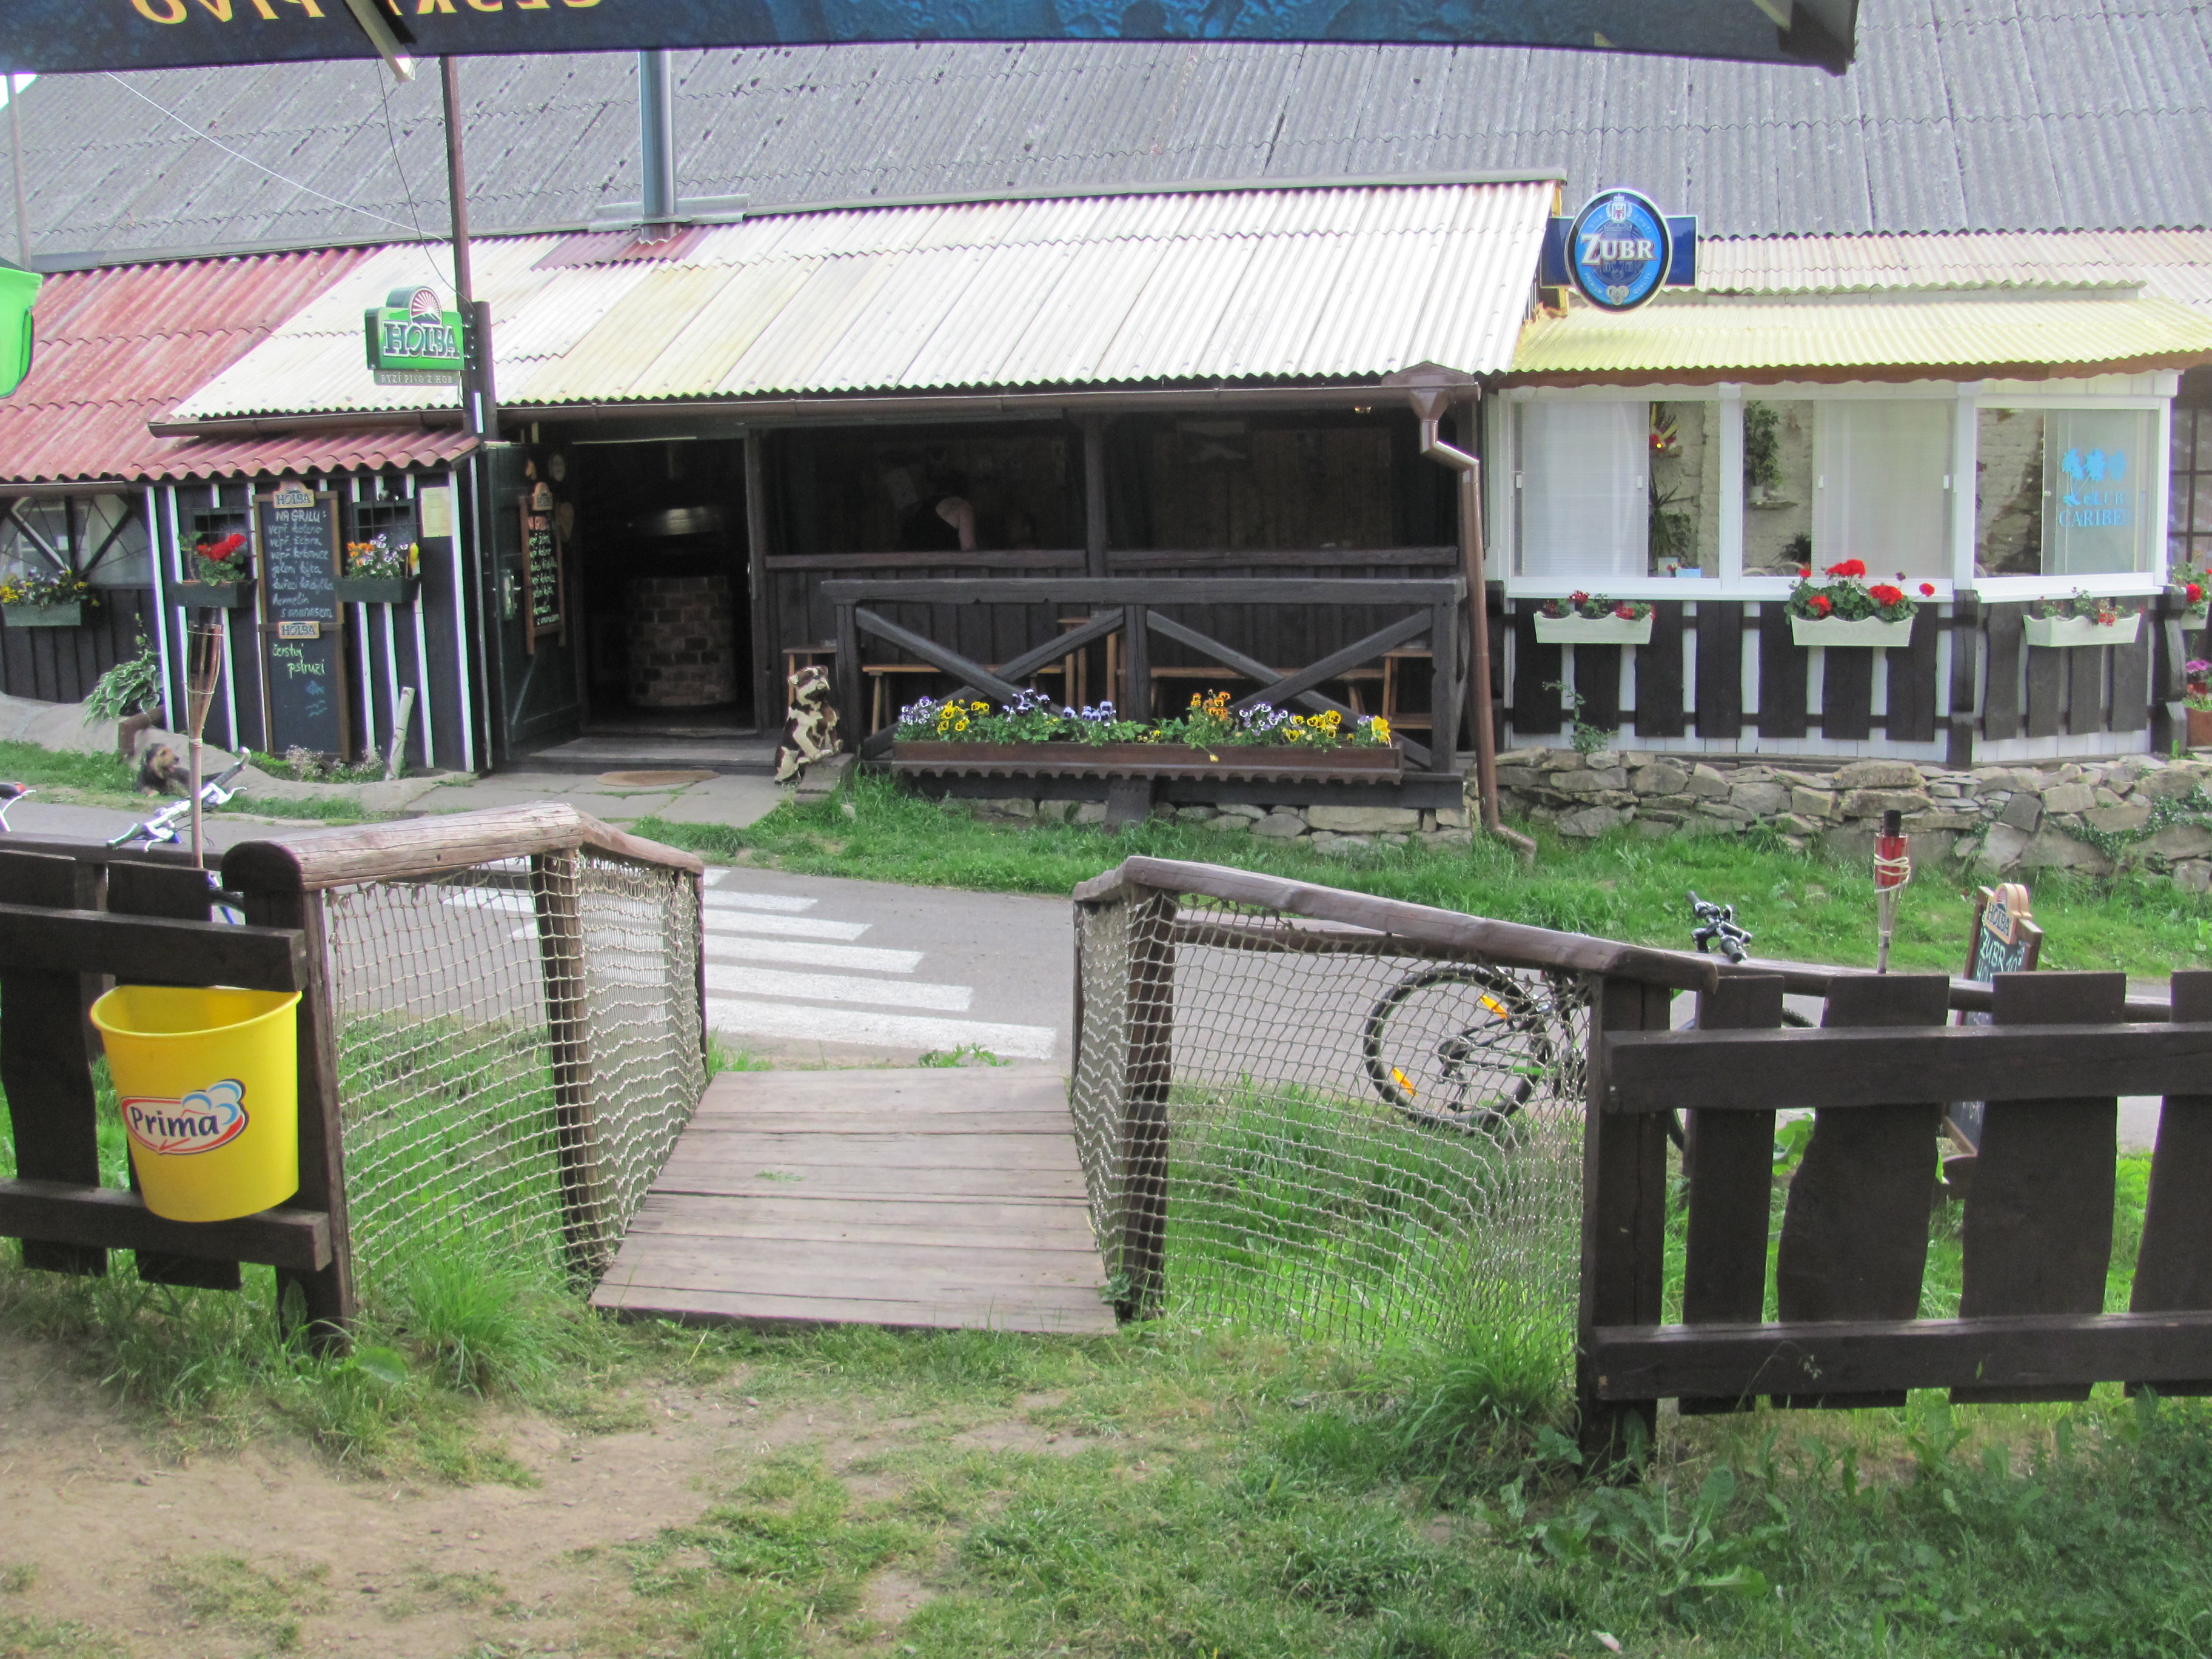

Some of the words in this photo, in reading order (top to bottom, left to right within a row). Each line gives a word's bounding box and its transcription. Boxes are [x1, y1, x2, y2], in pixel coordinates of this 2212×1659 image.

[1580, 233, 1658, 266] ZUBR
[1584, 272, 1603, 294] PREMIUM
[1633, 273, 1652, 295] QUALITY
[382, 320, 460, 360] HOLBA
[404, 375, 424, 383] PIVO
[427, 375, 433, 383] Z
[436, 375, 454, 384] HOR
[276, 494, 312, 504] HOLBA
[2083, 491, 2123, 506] CLUB
[276, 510, 289, 521] NA
[2059, 508, 2127, 527] CARIBE
[281, 624, 316, 635] HOLBA
[1988, 902, 2009, 937] HOLBA
[130, 1106, 220, 1138] Prima
